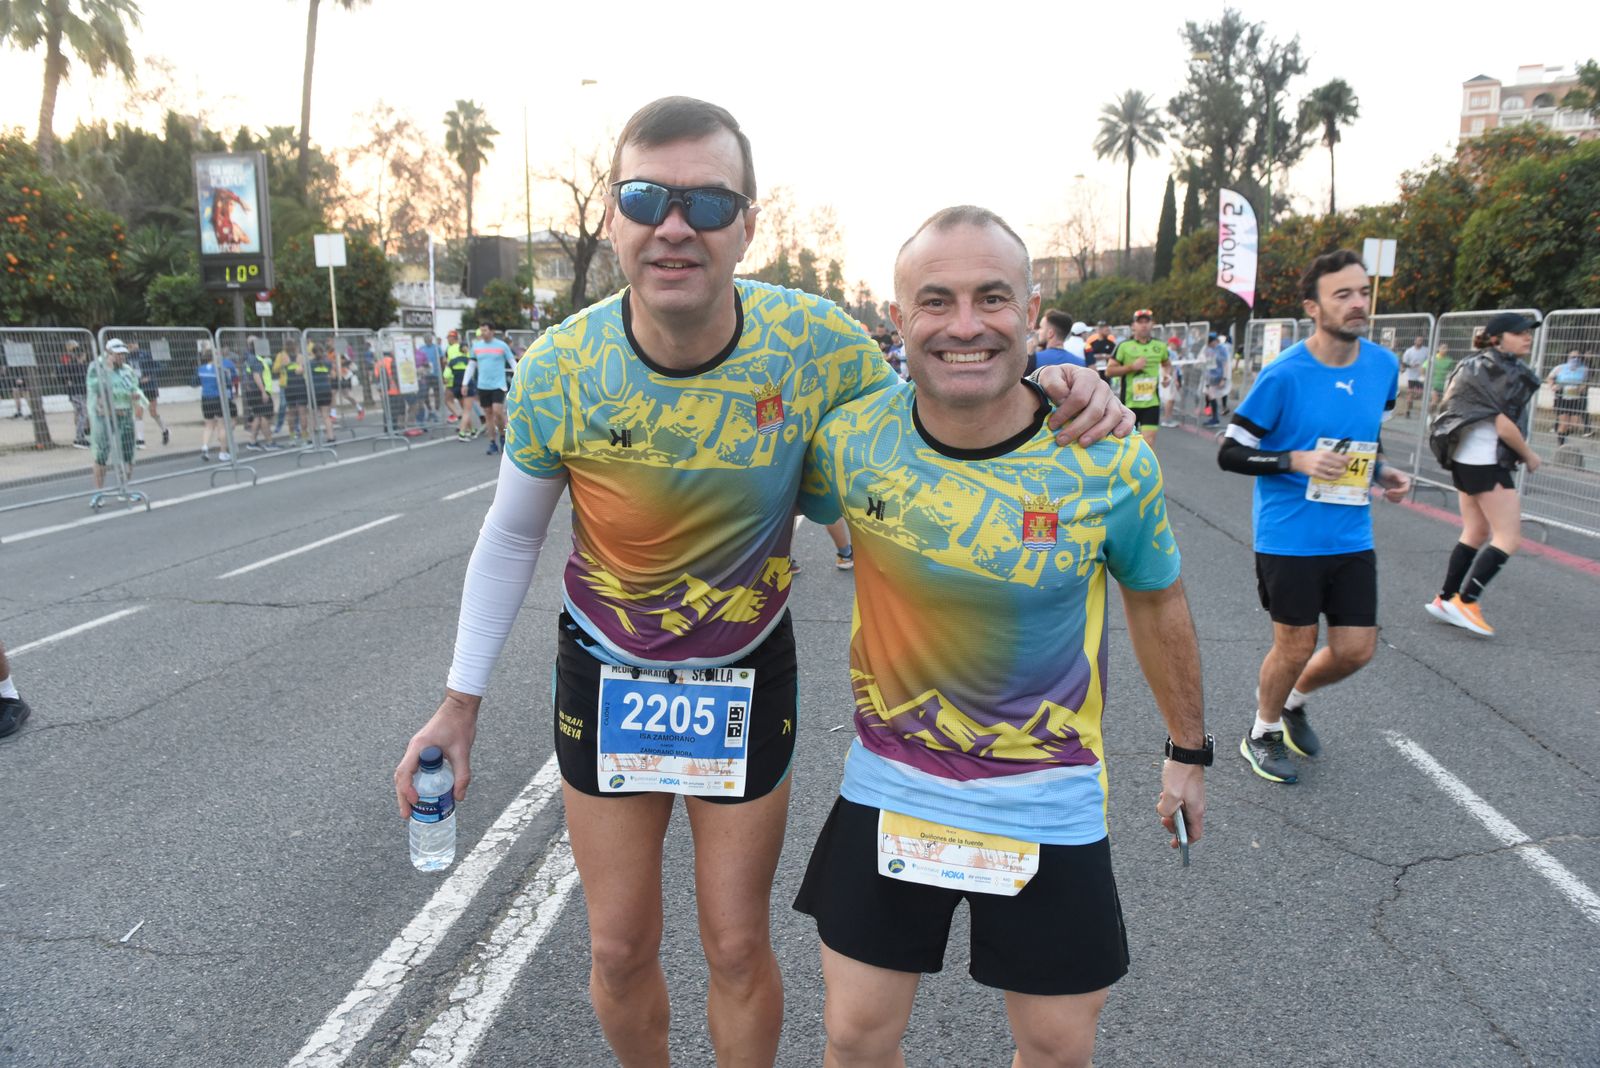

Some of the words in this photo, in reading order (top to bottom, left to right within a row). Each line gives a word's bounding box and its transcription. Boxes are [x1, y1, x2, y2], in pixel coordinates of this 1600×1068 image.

[1344, 457, 1370, 477] 47
[692, 667, 733, 683] SEILLA
[620, 691, 716, 736] 2205
[652, 734, 696, 743] ZAMORANO
[640, 747, 674, 755] ZAMORANO
[659, 776, 681, 785] HOKA
[964, 839, 984, 847] fuente
[941, 869, 965, 881] HOKA
